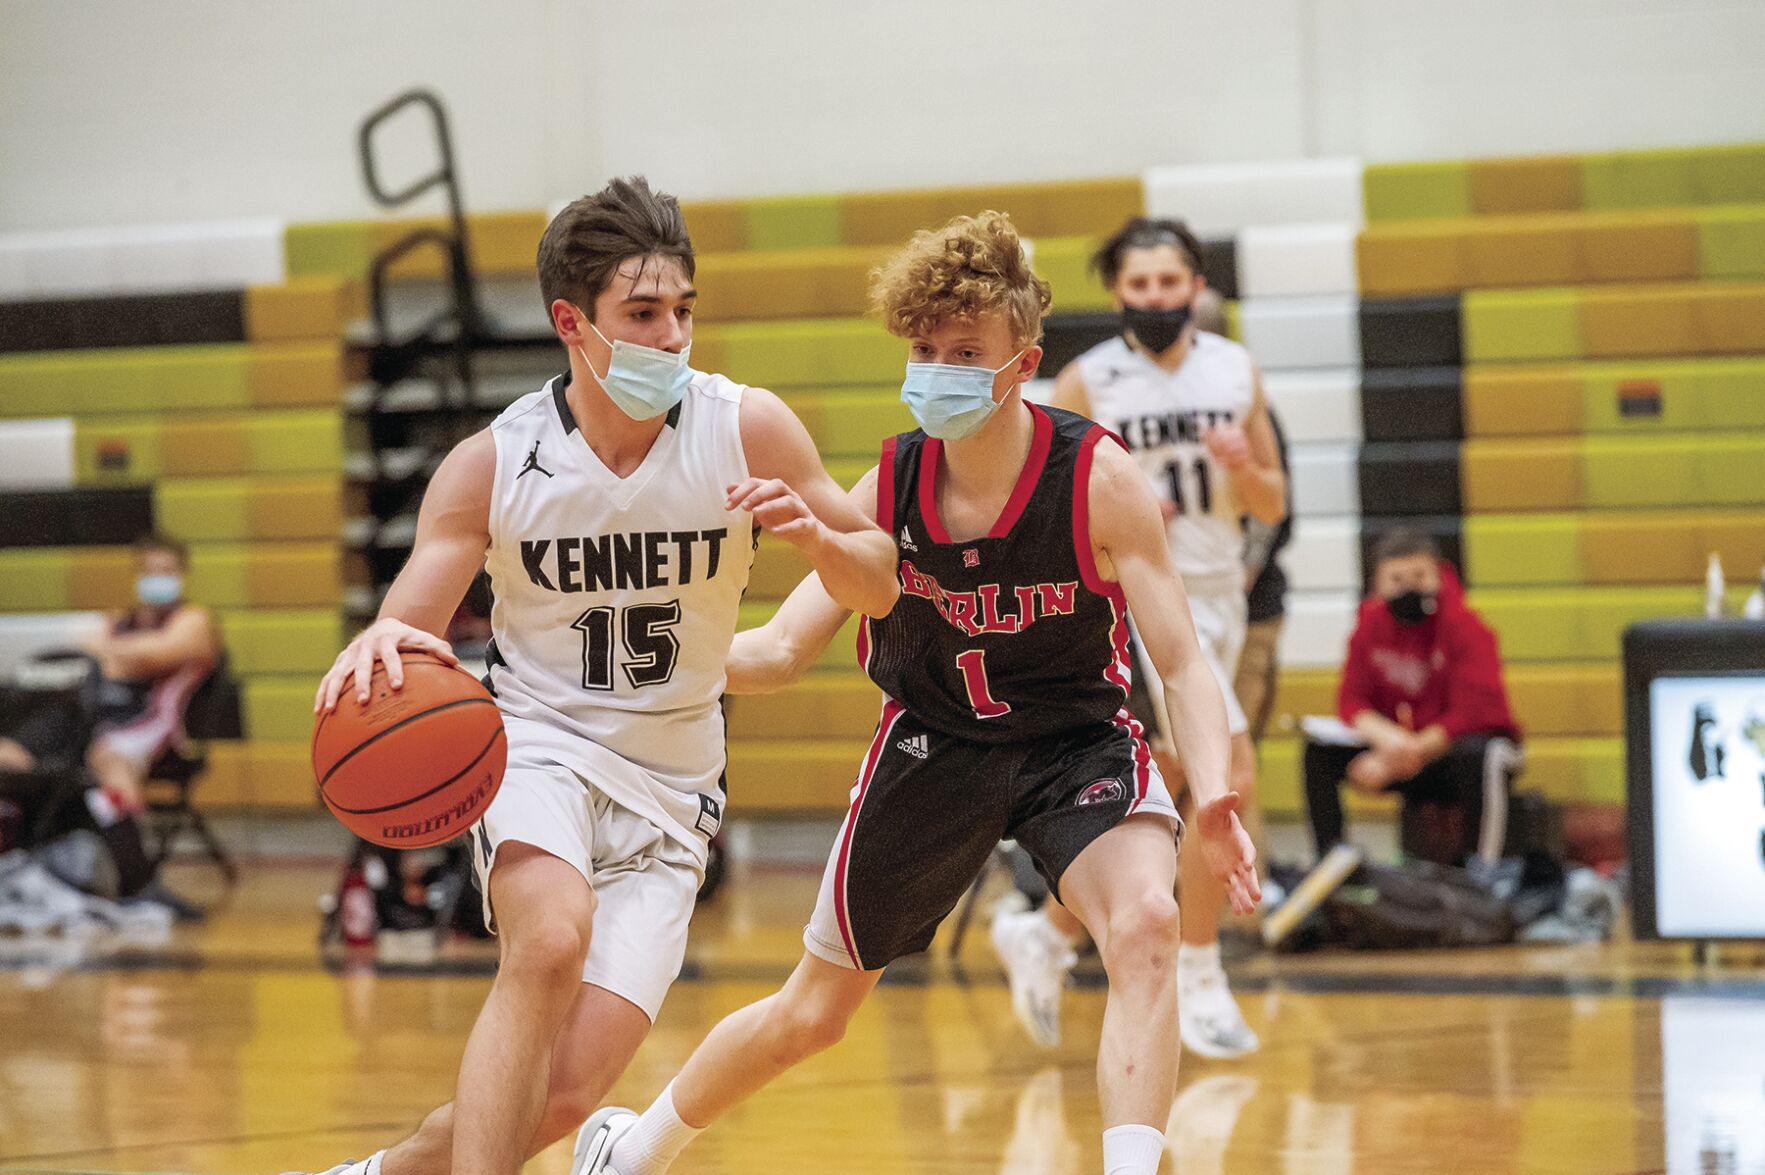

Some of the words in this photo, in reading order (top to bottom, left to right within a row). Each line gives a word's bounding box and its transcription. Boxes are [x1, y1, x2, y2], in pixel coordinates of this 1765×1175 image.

[1162, 457, 1211, 514] 11
[520, 528, 728, 593] KENNETT
[900, 560, 1079, 637] BERLIN
[569, 598, 682, 691] 15
[956, 649, 1012, 719] 1
[896, 741, 929, 759] adidas
